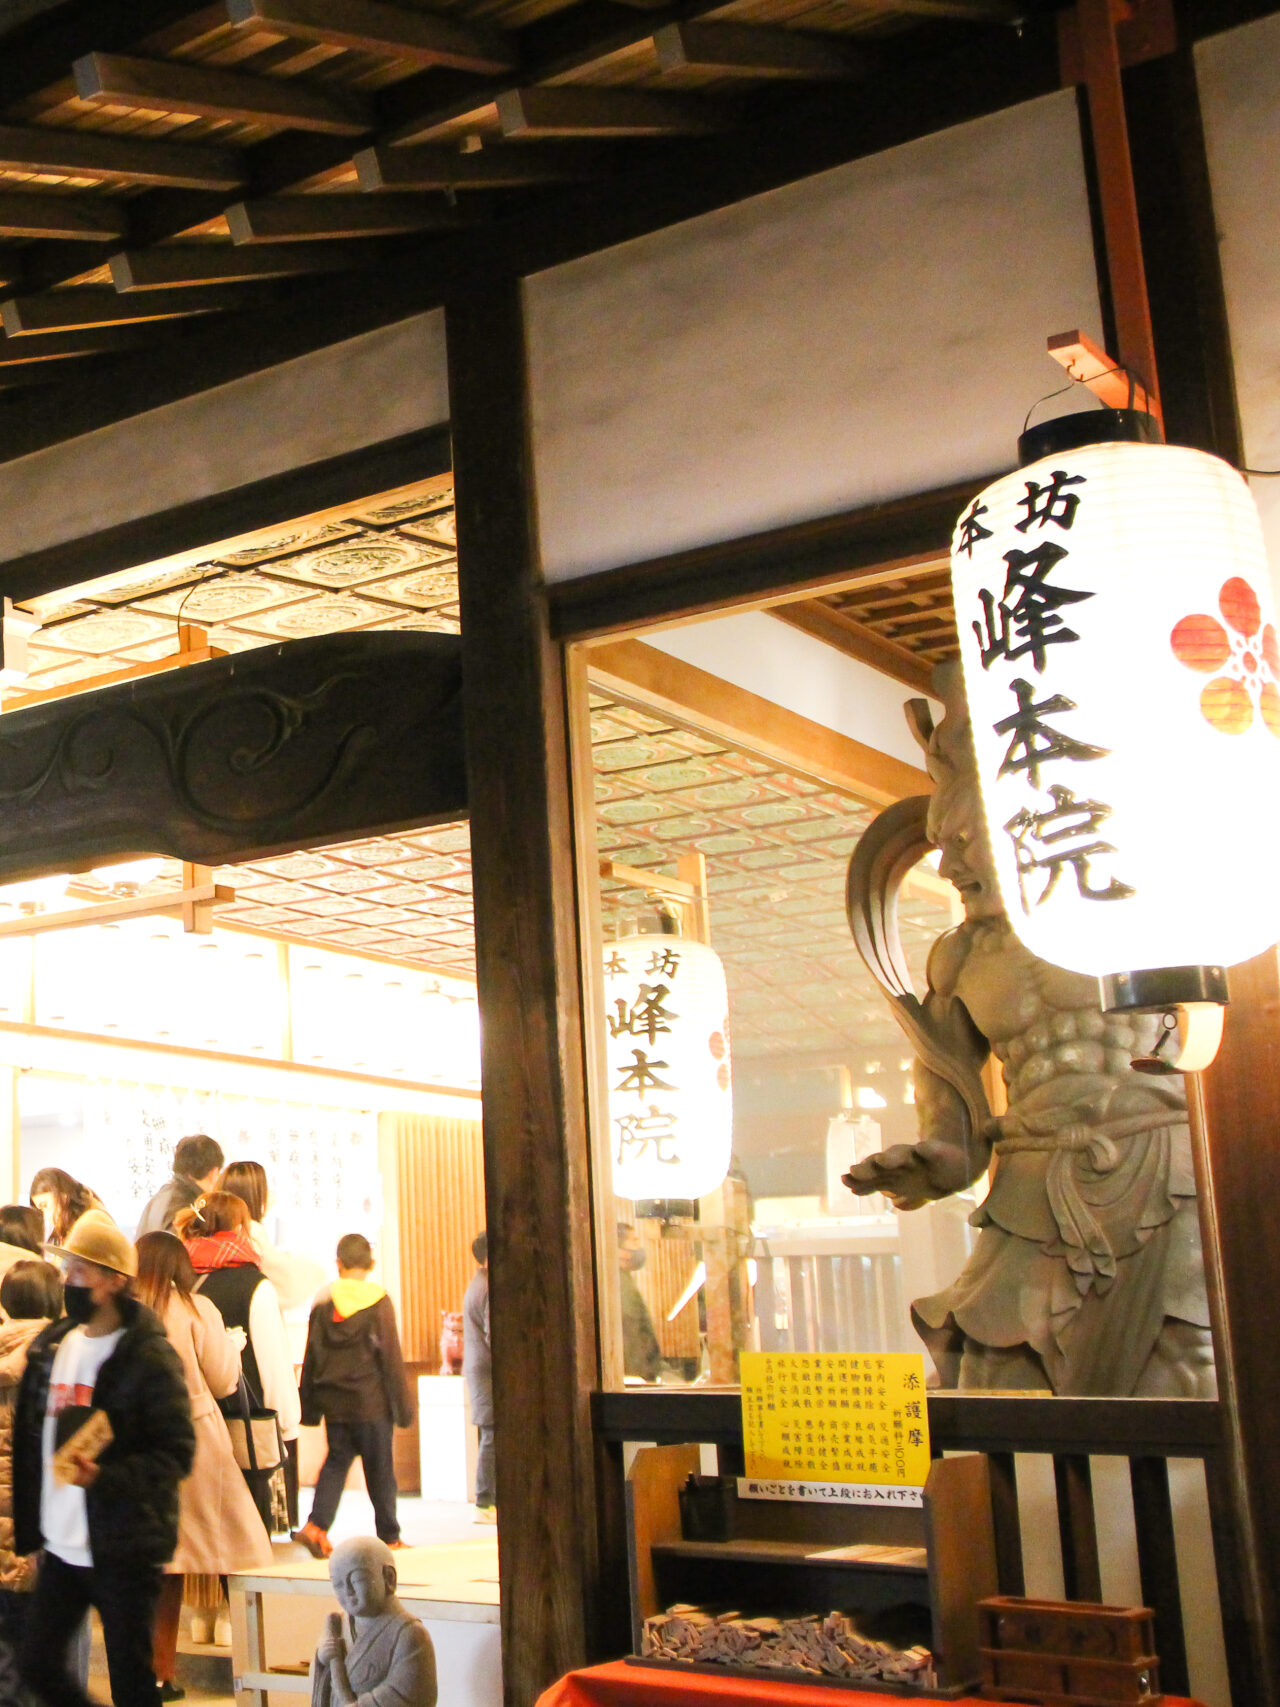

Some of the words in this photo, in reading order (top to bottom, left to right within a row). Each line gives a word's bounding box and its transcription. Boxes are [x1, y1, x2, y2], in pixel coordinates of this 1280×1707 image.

[973, 541, 1137, 917] 峰本院
[607, 984, 681, 1165] 峰本院
[903, 1373, 924, 1447] 添護摩
